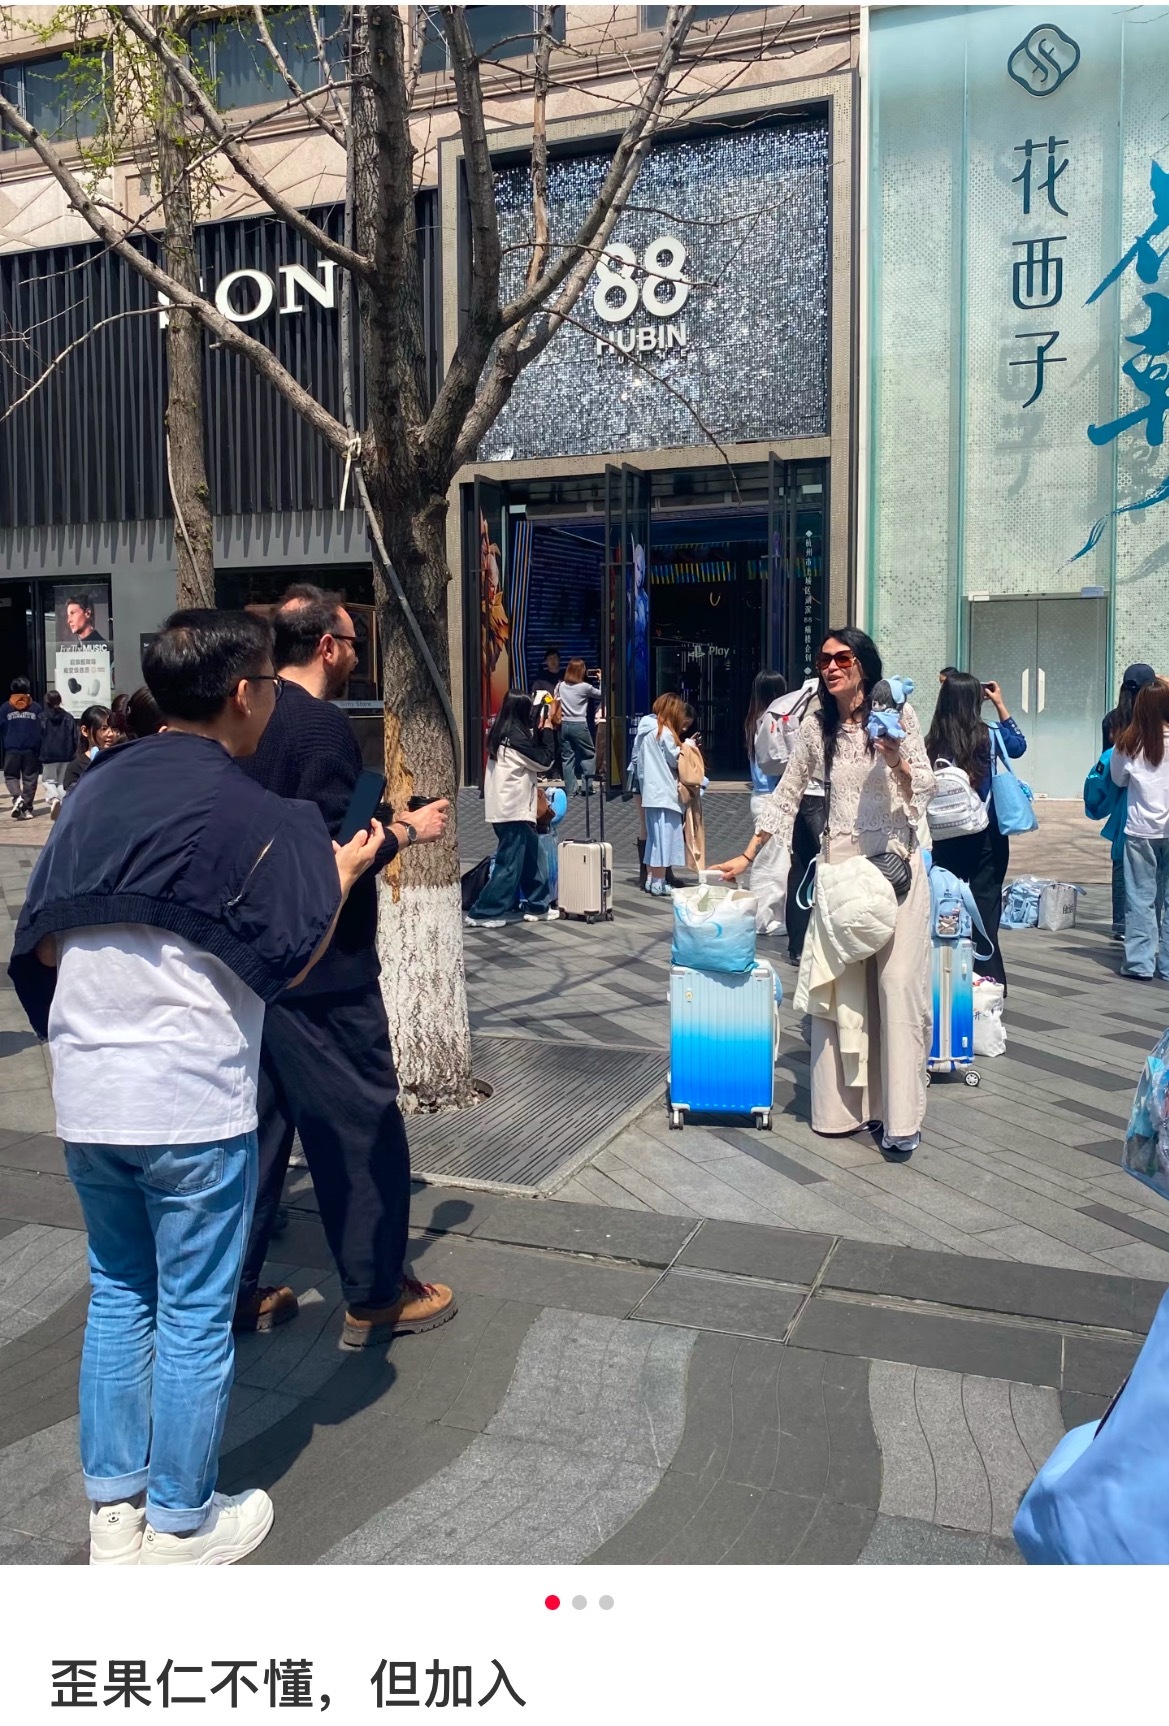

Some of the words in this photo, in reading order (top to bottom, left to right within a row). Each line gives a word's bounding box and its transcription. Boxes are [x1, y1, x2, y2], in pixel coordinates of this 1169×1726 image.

[158, 259, 339, 329] ON
[594, 235, 688, 322] 88
[1008, 136, 1069, 410] 花西子
[596, 322, 687, 355] HUBIN
[83, 644, 108, 652] MUSIC
[709, 646, 730, 658] Play
